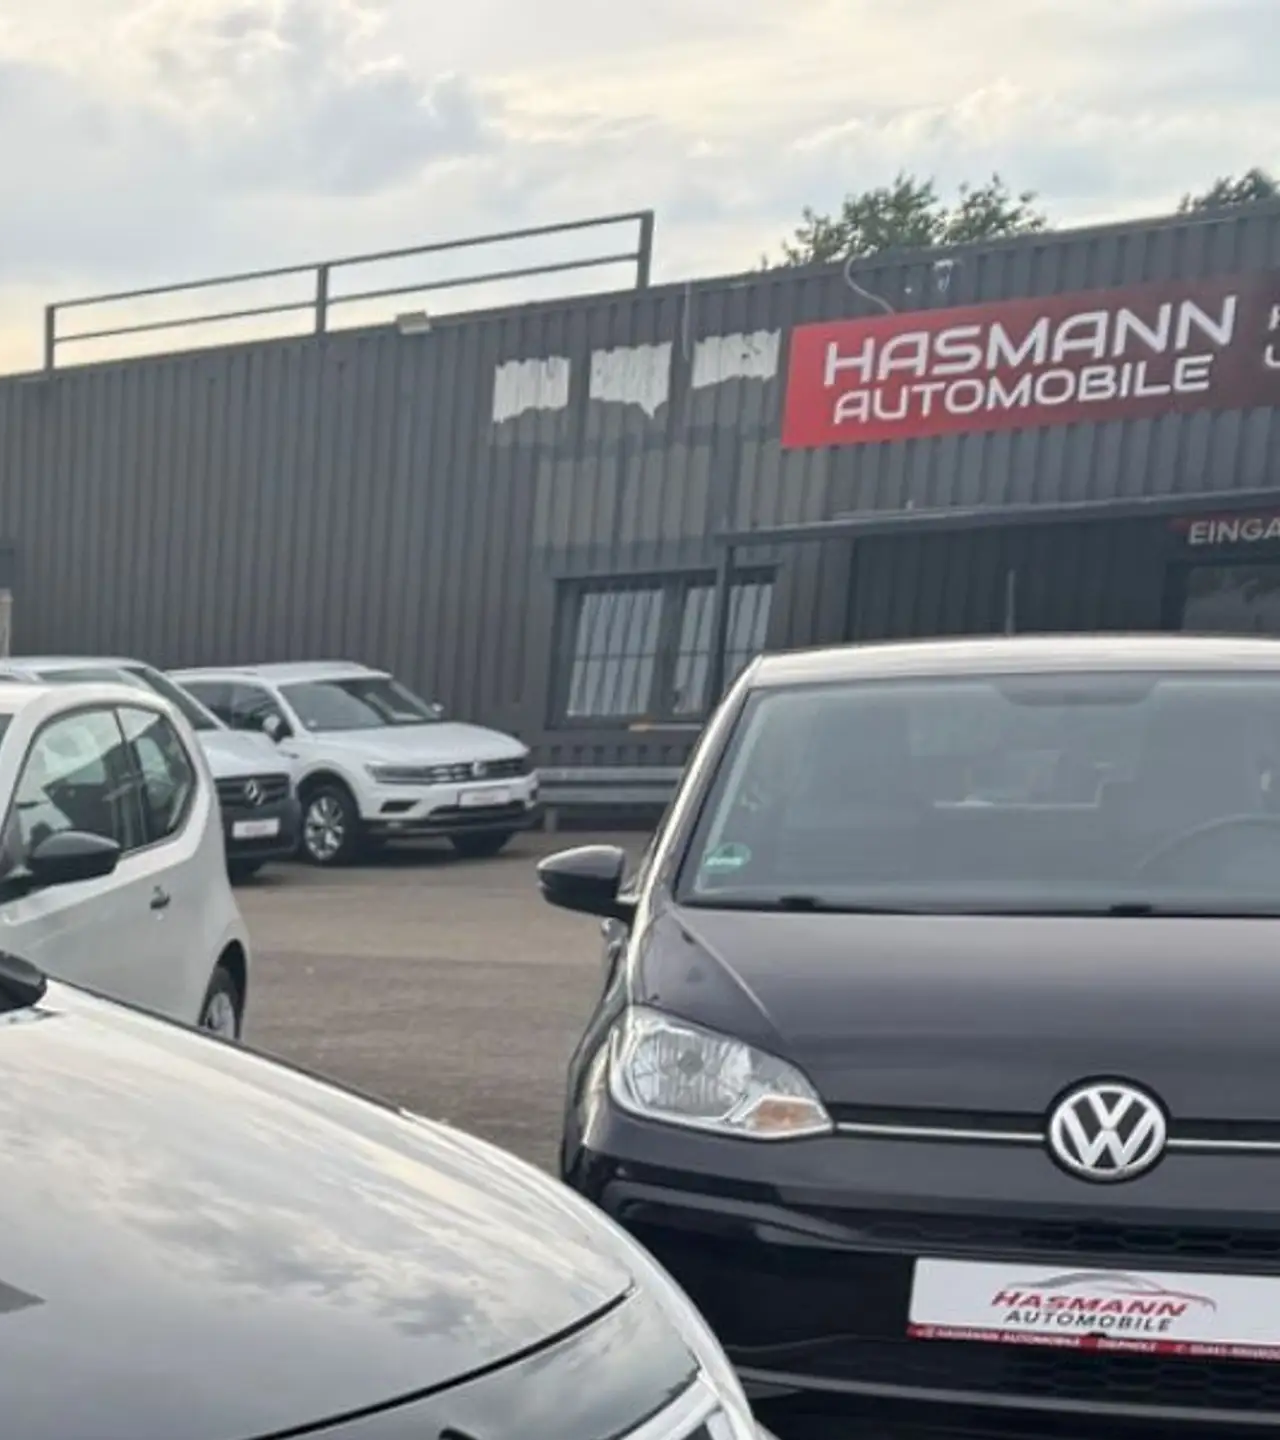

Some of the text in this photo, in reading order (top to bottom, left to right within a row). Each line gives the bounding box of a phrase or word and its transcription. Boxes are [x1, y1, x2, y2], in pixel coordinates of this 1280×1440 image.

[823, 295, 1238, 387] HASMANN
[833, 354, 1214, 425] AUTOMOBILE
[991, 1290, 1188, 1317] HASMANN
[1004, 1310, 1174, 1332] AUTOMOBILE
